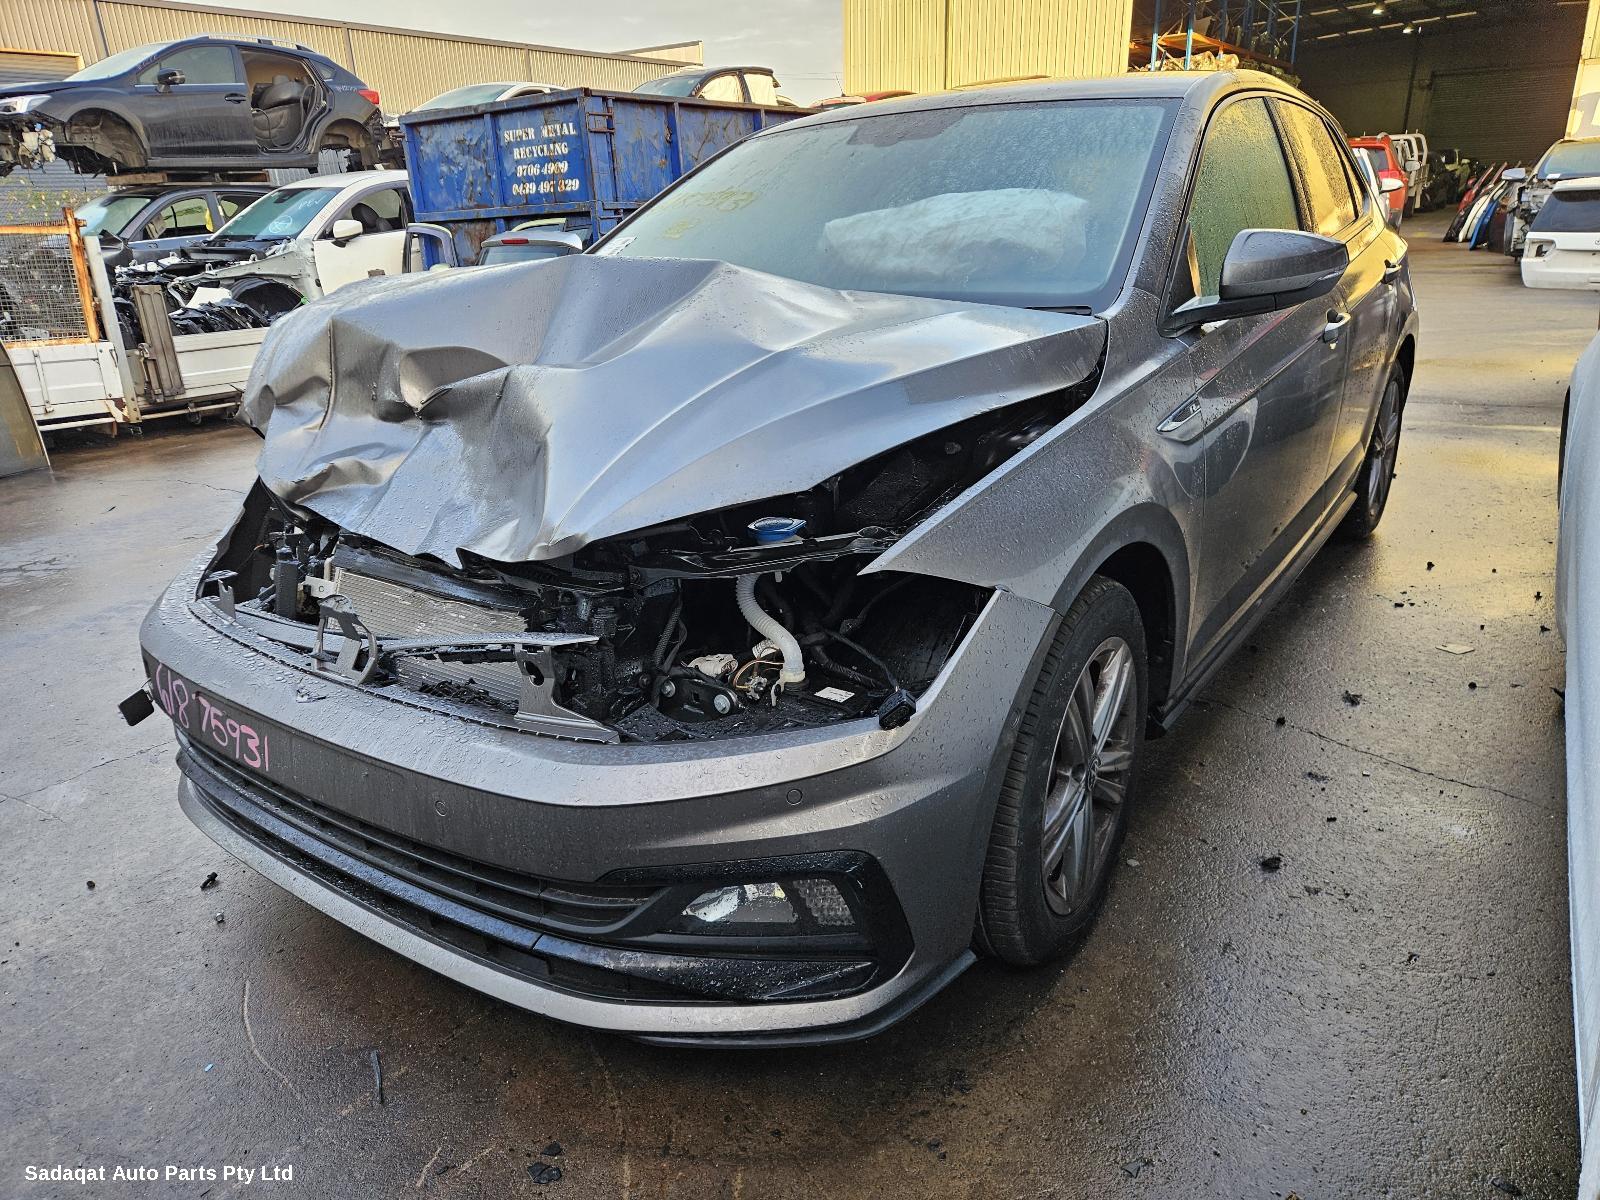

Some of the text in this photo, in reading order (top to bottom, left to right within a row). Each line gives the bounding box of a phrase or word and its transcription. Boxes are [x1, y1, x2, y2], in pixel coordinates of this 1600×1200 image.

[504, 122, 576, 143] SUPER METAL
[513, 142, 569, 160] RECYCLING
[516, 163, 541, 177] 9706
[512, 182, 536, 196] 0439
[538, 180, 556, 194] 497
[191, 692, 269, 772] 75931
